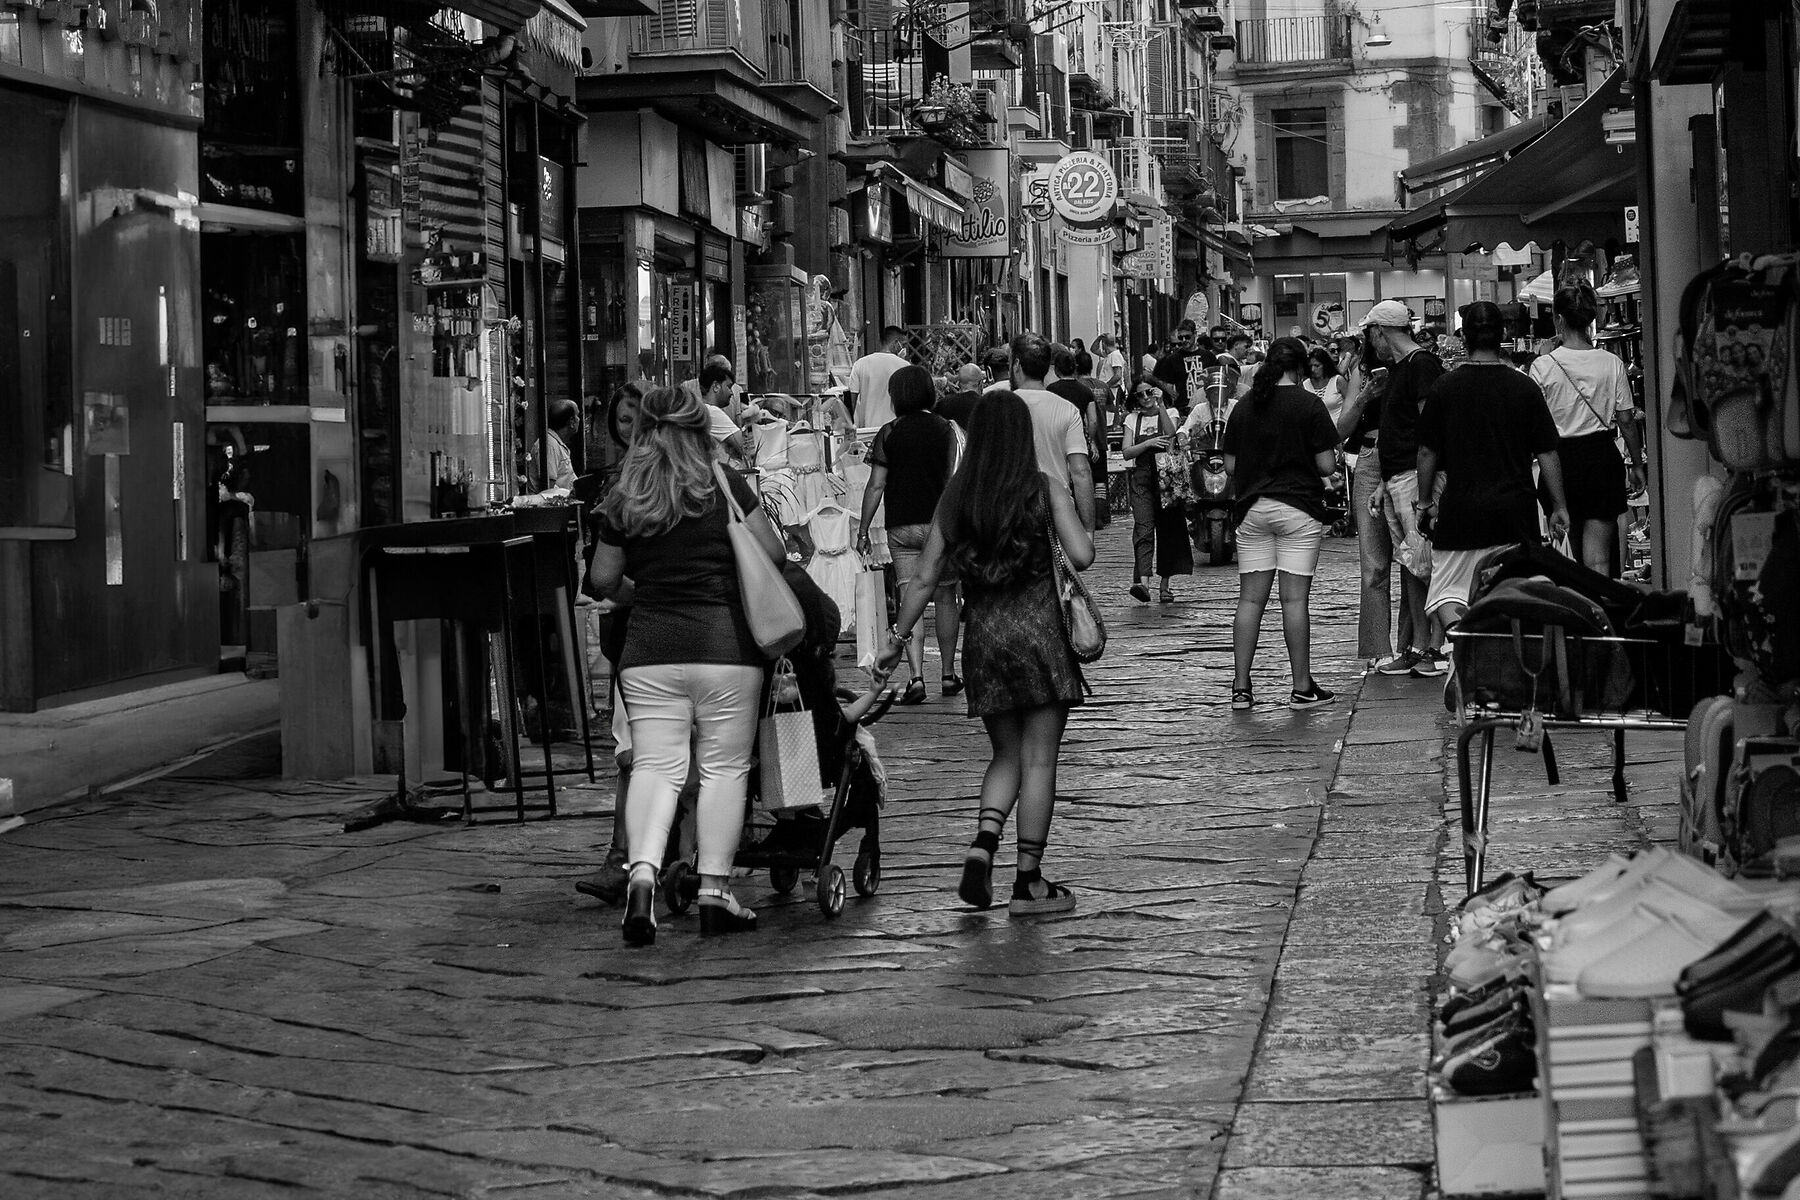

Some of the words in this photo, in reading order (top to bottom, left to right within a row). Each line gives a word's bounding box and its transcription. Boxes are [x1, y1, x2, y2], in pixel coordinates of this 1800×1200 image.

[1053, 175, 1063, 201] ANTICA
[1059, 157, 1088, 174] PIZZERIA
[1096, 162, 1113, 198] TRATTORIA
[1067, 171, 1100, 199] 22
[1063, 230, 1092, 243] Pizzeria
[1094, 235, 1101, 243] al
[1101, 230, 1111, 241] 22
